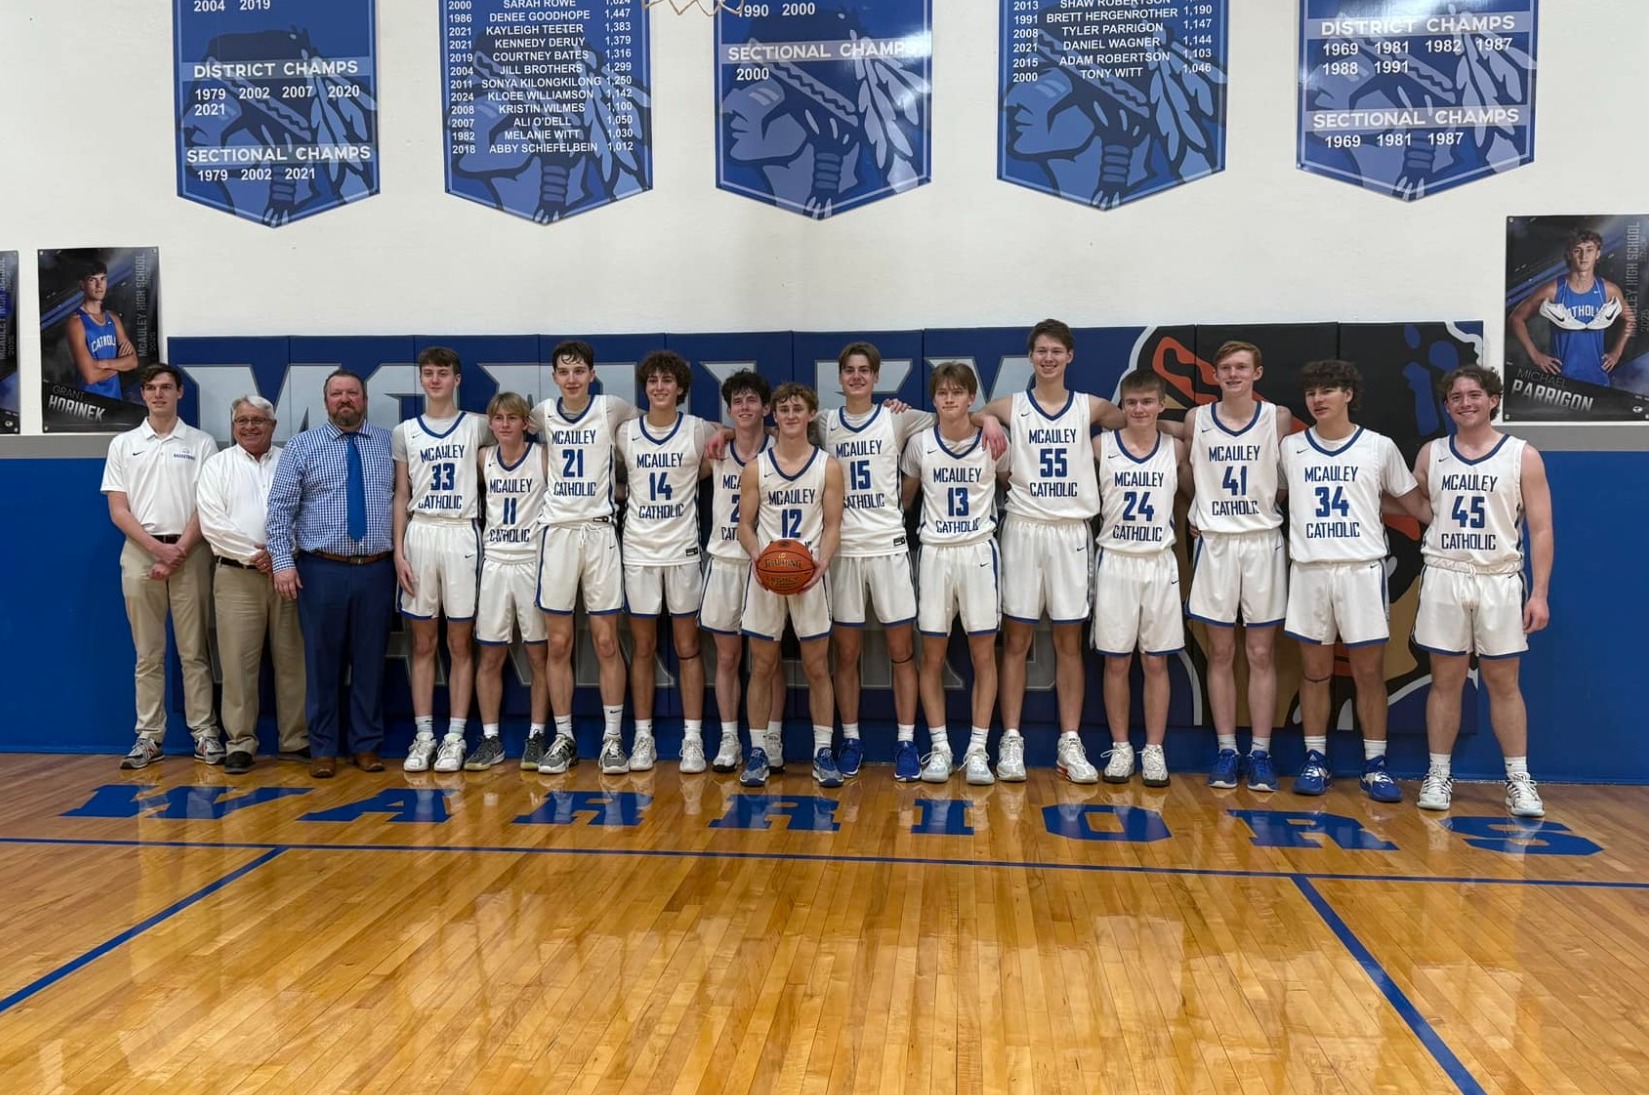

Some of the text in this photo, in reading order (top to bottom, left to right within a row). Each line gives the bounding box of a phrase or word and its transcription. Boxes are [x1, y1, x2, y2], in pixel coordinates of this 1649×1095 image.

[194, 0, 270, 12] 2004 2019
[449, 1, 471, 9] 2000
[504, 0, 546, 8] SARAH
[782, 3, 815, 16] 2000
[1013, 1, 1038, 11] 2013
[1060, 0, 1092, 8] SHAW
[449, 9, 630, 22] 1986 DENEE GOODHOPE 1,447
[1014, 5, 1212, 24] 1991 BRETT HERGENROTHER 1,190
[449, 23, 630, 36] 2021 KAYLEIGH TEETER 1,383
[1013, 19, 1211, 38] 2008 TYLER PARRIGON 1,147
[1321, 16, 1515, 35] DISTRICT CHAMPS
[449, 36, 631, 49] 2021 KENNEDY DERUY 1,379
[1013, 35, 1211, 52] 2021 DANIEL WAGNER 1,144
[1323, 38, 1512, 56] 1969 1981 1982 1987
[450, 50, 631, 62] 2019 COURTNEY BATES 1,316
[728, 44, 830, 61] SECTIONAL
[1013, 49, 1211, 67] 2015 ADAM ROBERTSON 1,103
[194, 61, 358, 78] DISTRICT CHAMPS
[450, 63, 631, 75] 2004 JILL BROTHERS 1,299
[737, 68, 769, 80] 2000
[1013, 63, 1211, 82] 2000 TONY WITT 1,046
[1323, 61, 1408, 75] 1988 1991
[451, 76, 632, 89] 2011 SONYA KILONGKILONG 1,250
[196, 86, 359, 100] 1979 2002 2007 2020
[451, 90, 632, 101] 2024 KLOEE WILLIAMSON 1,142
[195, 104, 225, 115] 2021
[452, 102, 632, 114] 2008 KRISTIN WILMES 1,100
[452, 116, 633, 128] 2007 ALI O'DELL 1,050
[1313, 109, 1519, 128] SECTIONAL CHAMPS
[453, 129, 633, 141] 1982 MELANIE WITT 1,030
[1325, 132, 1464, 148] 1969 1981 1987
[187, 146, 371, 163] SECTIONAL CHAMPS
[453, 142, 633, 154] 2018 ABBY SCHIEFELBEIN 1,012
[198, 168, 315, 181] 1979 2002 2021
[1511, 378, 1594, 413] PARRIGON
[49, 394, 106, 421] HORINEK
[552, 430, 596, 444] MCAULEY
[1029, 429, 1076, 445] MCAULEY
[420, 445, 464, 463] MCAULEY
[836, 440, 882, 458] MCAULEY
[1208, 445, 1261, 462] MCAULEY
[563, 450, 583, 477] 21
[637, 453, 683, 468] MCAULEY
[1040, 448, 1067, 477] 55
[431, 463, 455, 491] 33
[850, 460, 871, 490] 15
[933, 468, 982, 483] MCAULEY
[1114, 471, 1164, 487] MCAULEY
[1222, 466, 1247, 496] 41
[1305, 466, 1358, 483] MCAULEY
[1441, 474, 1498, 492] MCAULEY
[489, 478, 533, 494] MCAULEY
[554, 482, 596, 496] CATHOLIC
[649, 472, 672, 501] 14
[1029, 482, 1077, 498] CATHOLIC
[768, 489, 815, 505] MCAULEY
[948, 487, 969, 516] 13
[1315, 487, 1349, 518] 34
[503, 498, 516, 525] 11
[639, 504, 684, 519] CATHOLIC
[1123, 491, 1154, 521] 24
[1452, 495, 1485, 529] 45
[782, 509, 802, 538] 12
[1306, 522, 1360, 539] CATHOLIC
[490, 529, 530, 544] CATHOLIC
[1113, 525, 1162, 542] CATHOLIC
[1441, 533, 1496, 550] CATHOLIC
